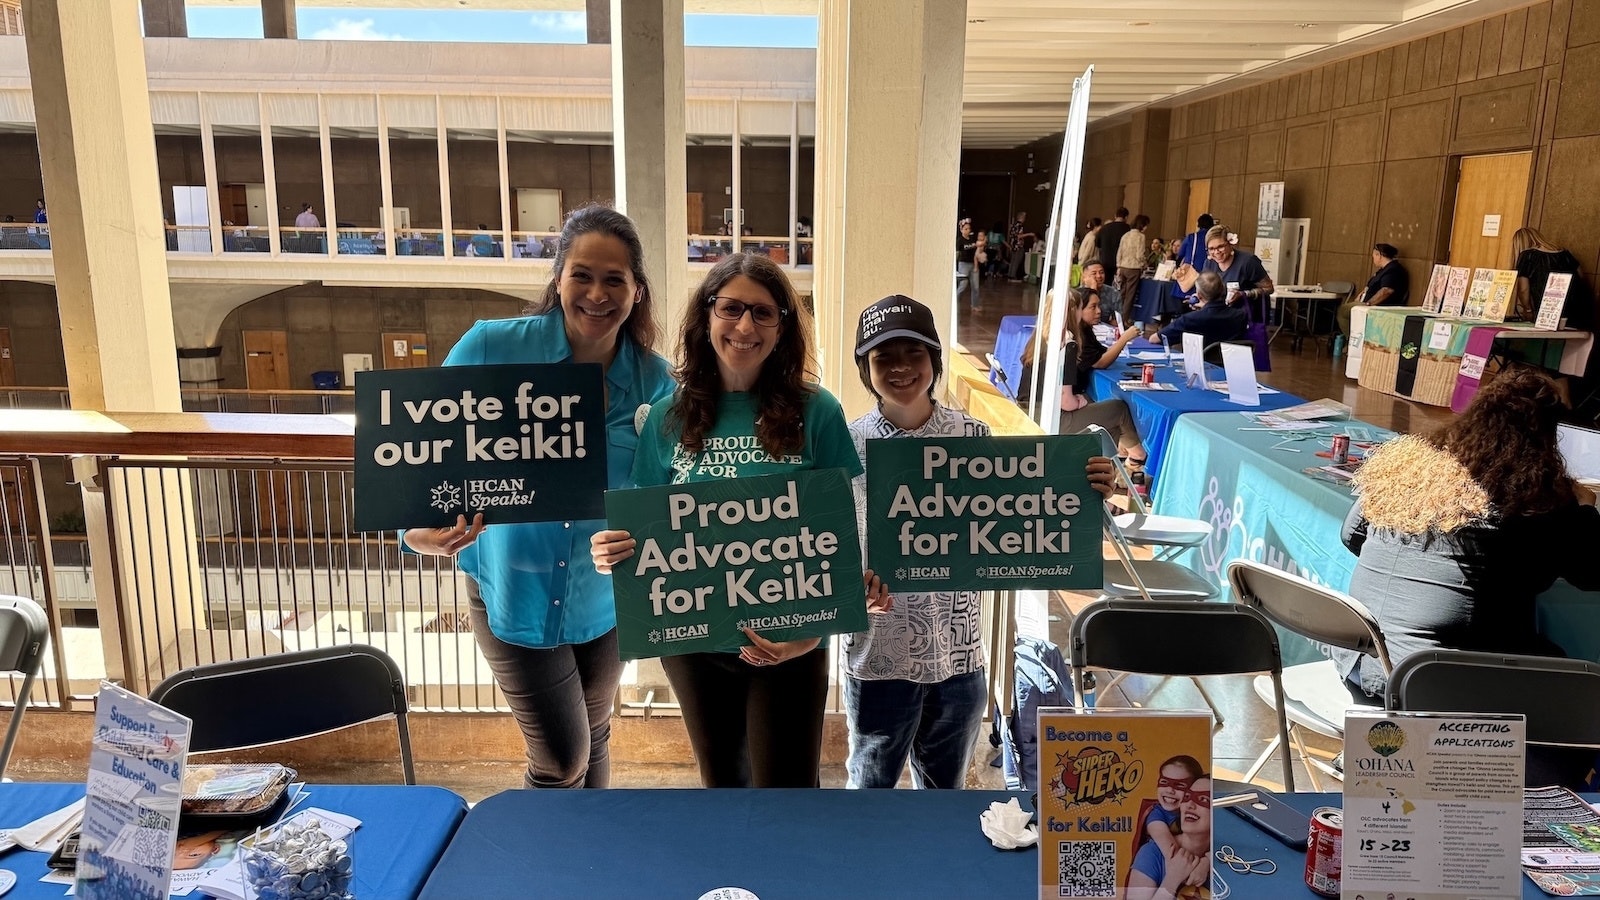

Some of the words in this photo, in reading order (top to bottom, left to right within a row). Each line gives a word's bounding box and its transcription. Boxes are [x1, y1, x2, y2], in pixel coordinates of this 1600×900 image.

[863, 305, 878, 318] no
[380, 389, 391, 426] I
[402, 390, 503, 424] vote
[514, 382, 582, 420] for
[374, 440, 454, 467] our
[466, 421, 587, 462] keiki!
[696, 465, 738, 478] FOR
[922, 442, 1045, 480] Proud
[469, 478, 525, 493] HCAN
[469, 490, 536, 511] Speaks!
[668, 480, 800, 530] Proud
[888, 482, 1081, 518] Advocate
[898, 520, 958, 556] for
[969, 519, 1070, 554] Keiki
[634, 526, 838, 576] Advocate
[910, 566, 950, 577] HCAN
[649, 576, 714, 616] for
[725, 560, 833, 608] Keiki
[665, 624, 708, 640] HCAN
[110, 705, 147, 733] Support
[1439, 723, 1511, 733] ACCEPTING
[1046, 726, 1112, 741] Become
[1117, 731, 1128, 741] a
[1434, 738, 1515, 748] APPLICATIONS
[112, 756, 156, 794] Education
[146, 749, 169, 774] Care
[171, 762, 180, 780] &
[1073, 752, 1115, 775] SUPER
[1076, 760, 1144, 800] HERO
[1382, 801, 1391, 814] 4
[1047, 816, 1073, 832] for
[1078, 816, 1132, 832] Keiki!!
[1360, 839, 1376, 851] 15
[1392, 840, 1411, 851] 23
